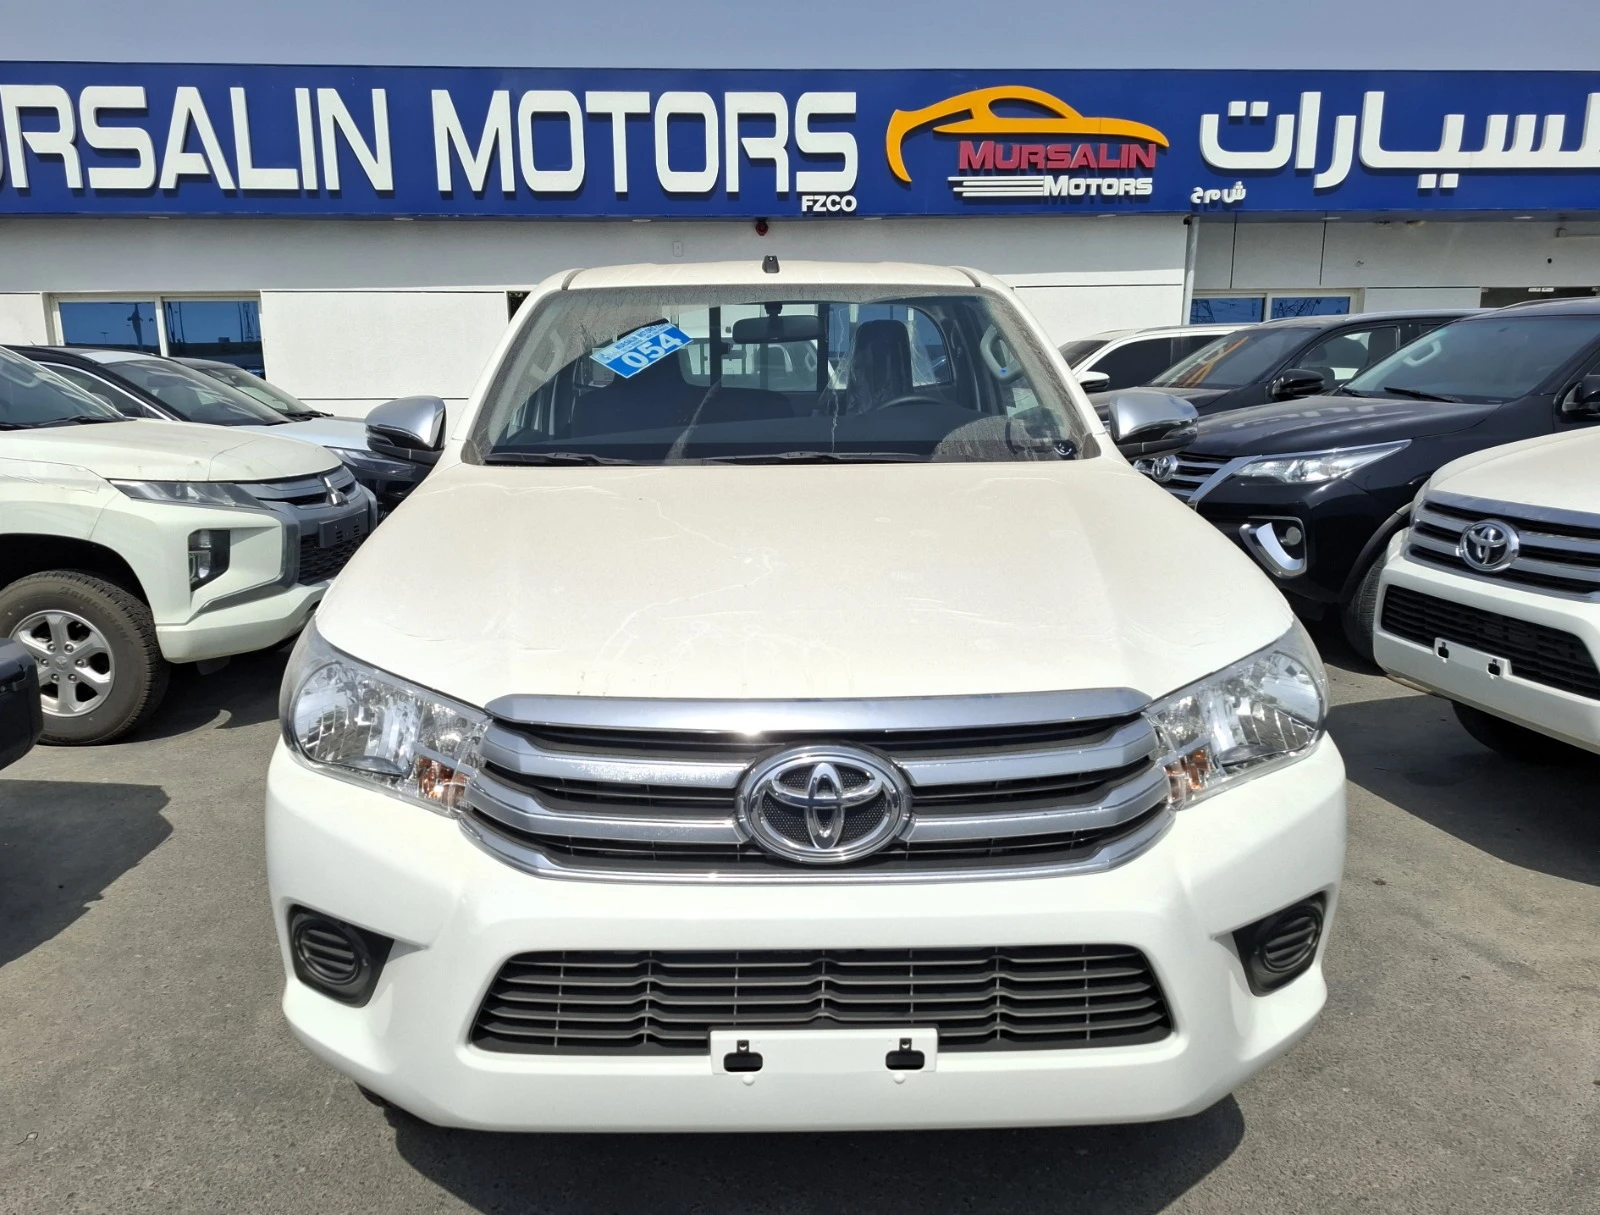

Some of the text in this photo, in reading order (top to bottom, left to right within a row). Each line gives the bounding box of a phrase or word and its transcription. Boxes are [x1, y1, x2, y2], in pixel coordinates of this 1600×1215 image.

[0, 85, 858, 193] RSALIN MOTORS
[959, 141, 1157, 170] MURSALIN
[1043, 175, 1153, 197] MOTORS
[801, 195, 857, 212] FZCO
[621, 333, 682, 368] 054
